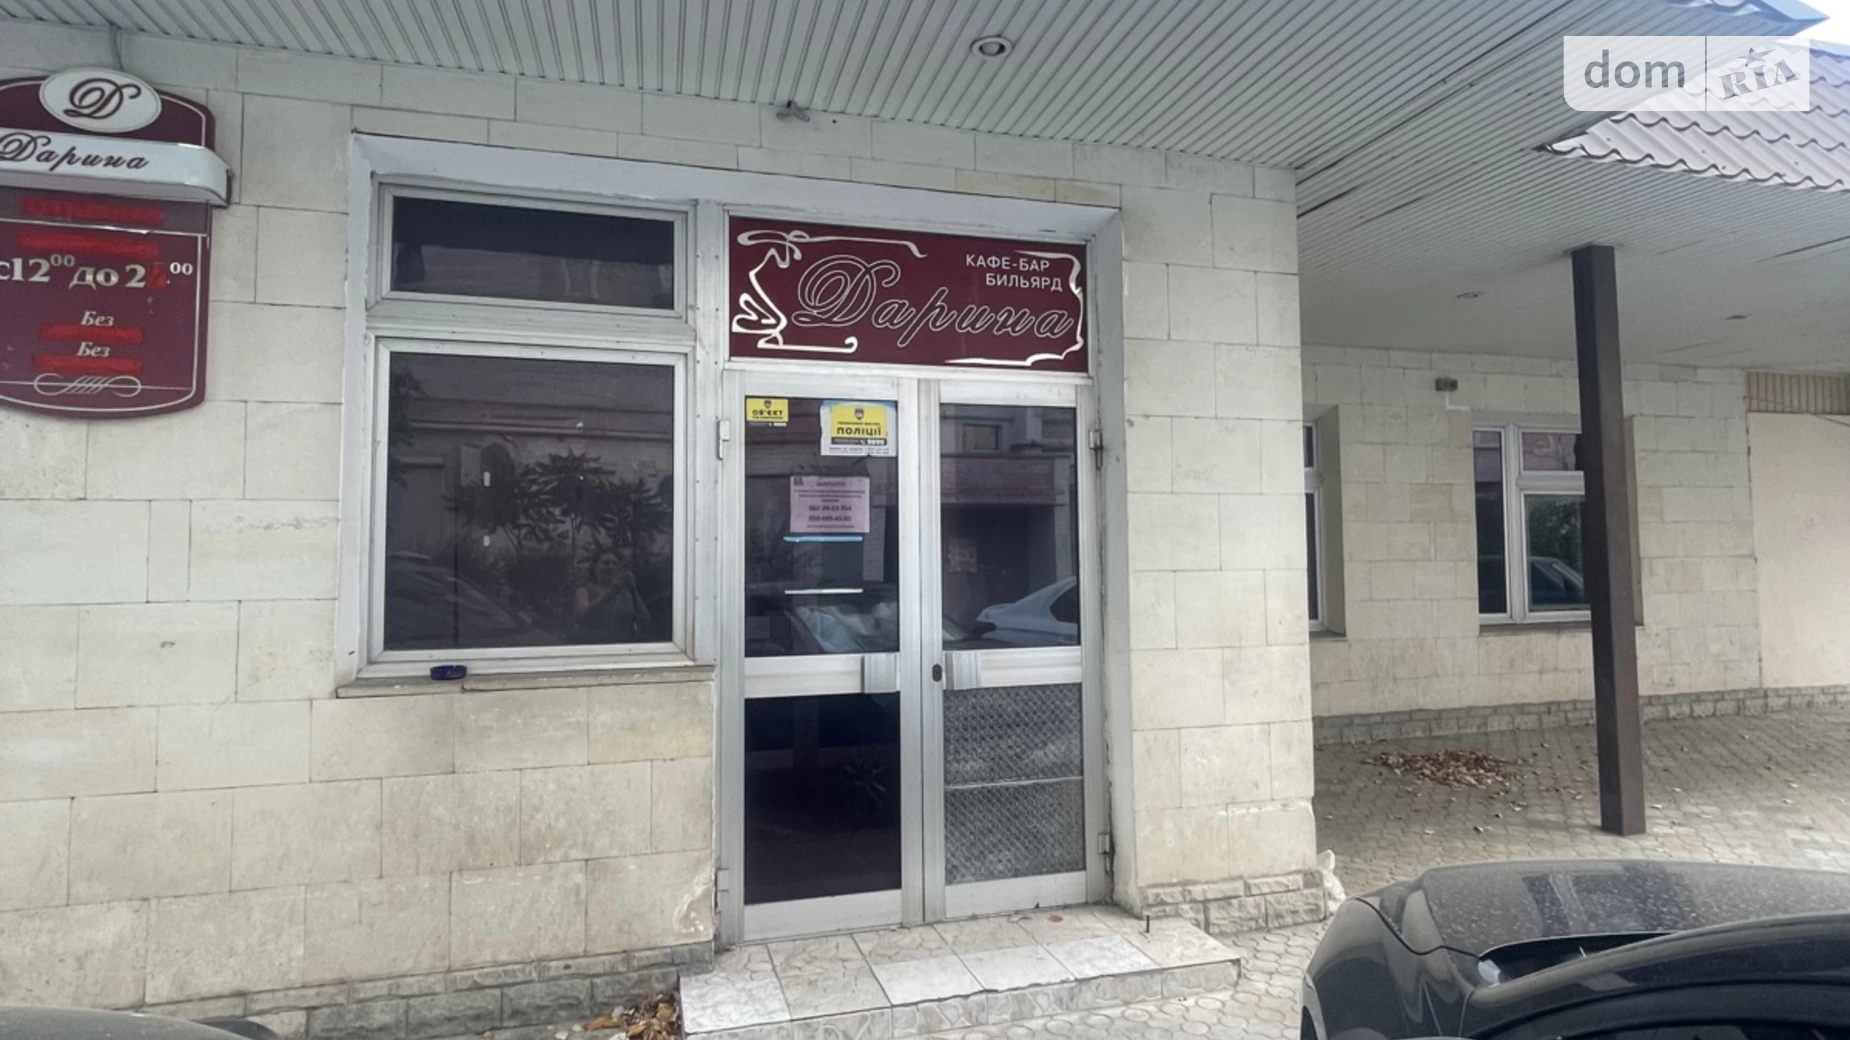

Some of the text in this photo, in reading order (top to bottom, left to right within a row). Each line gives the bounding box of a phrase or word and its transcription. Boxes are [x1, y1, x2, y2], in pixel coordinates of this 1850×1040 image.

[966, 254, 1051, 272] КАФЕ-БАР
[985, 272, 1063, 292] БИЛЬЯРД
[792, 254, 1074, 348] Дарина
[80, 310, 115, 327] Без
[76, 341, 111, 358] Без
